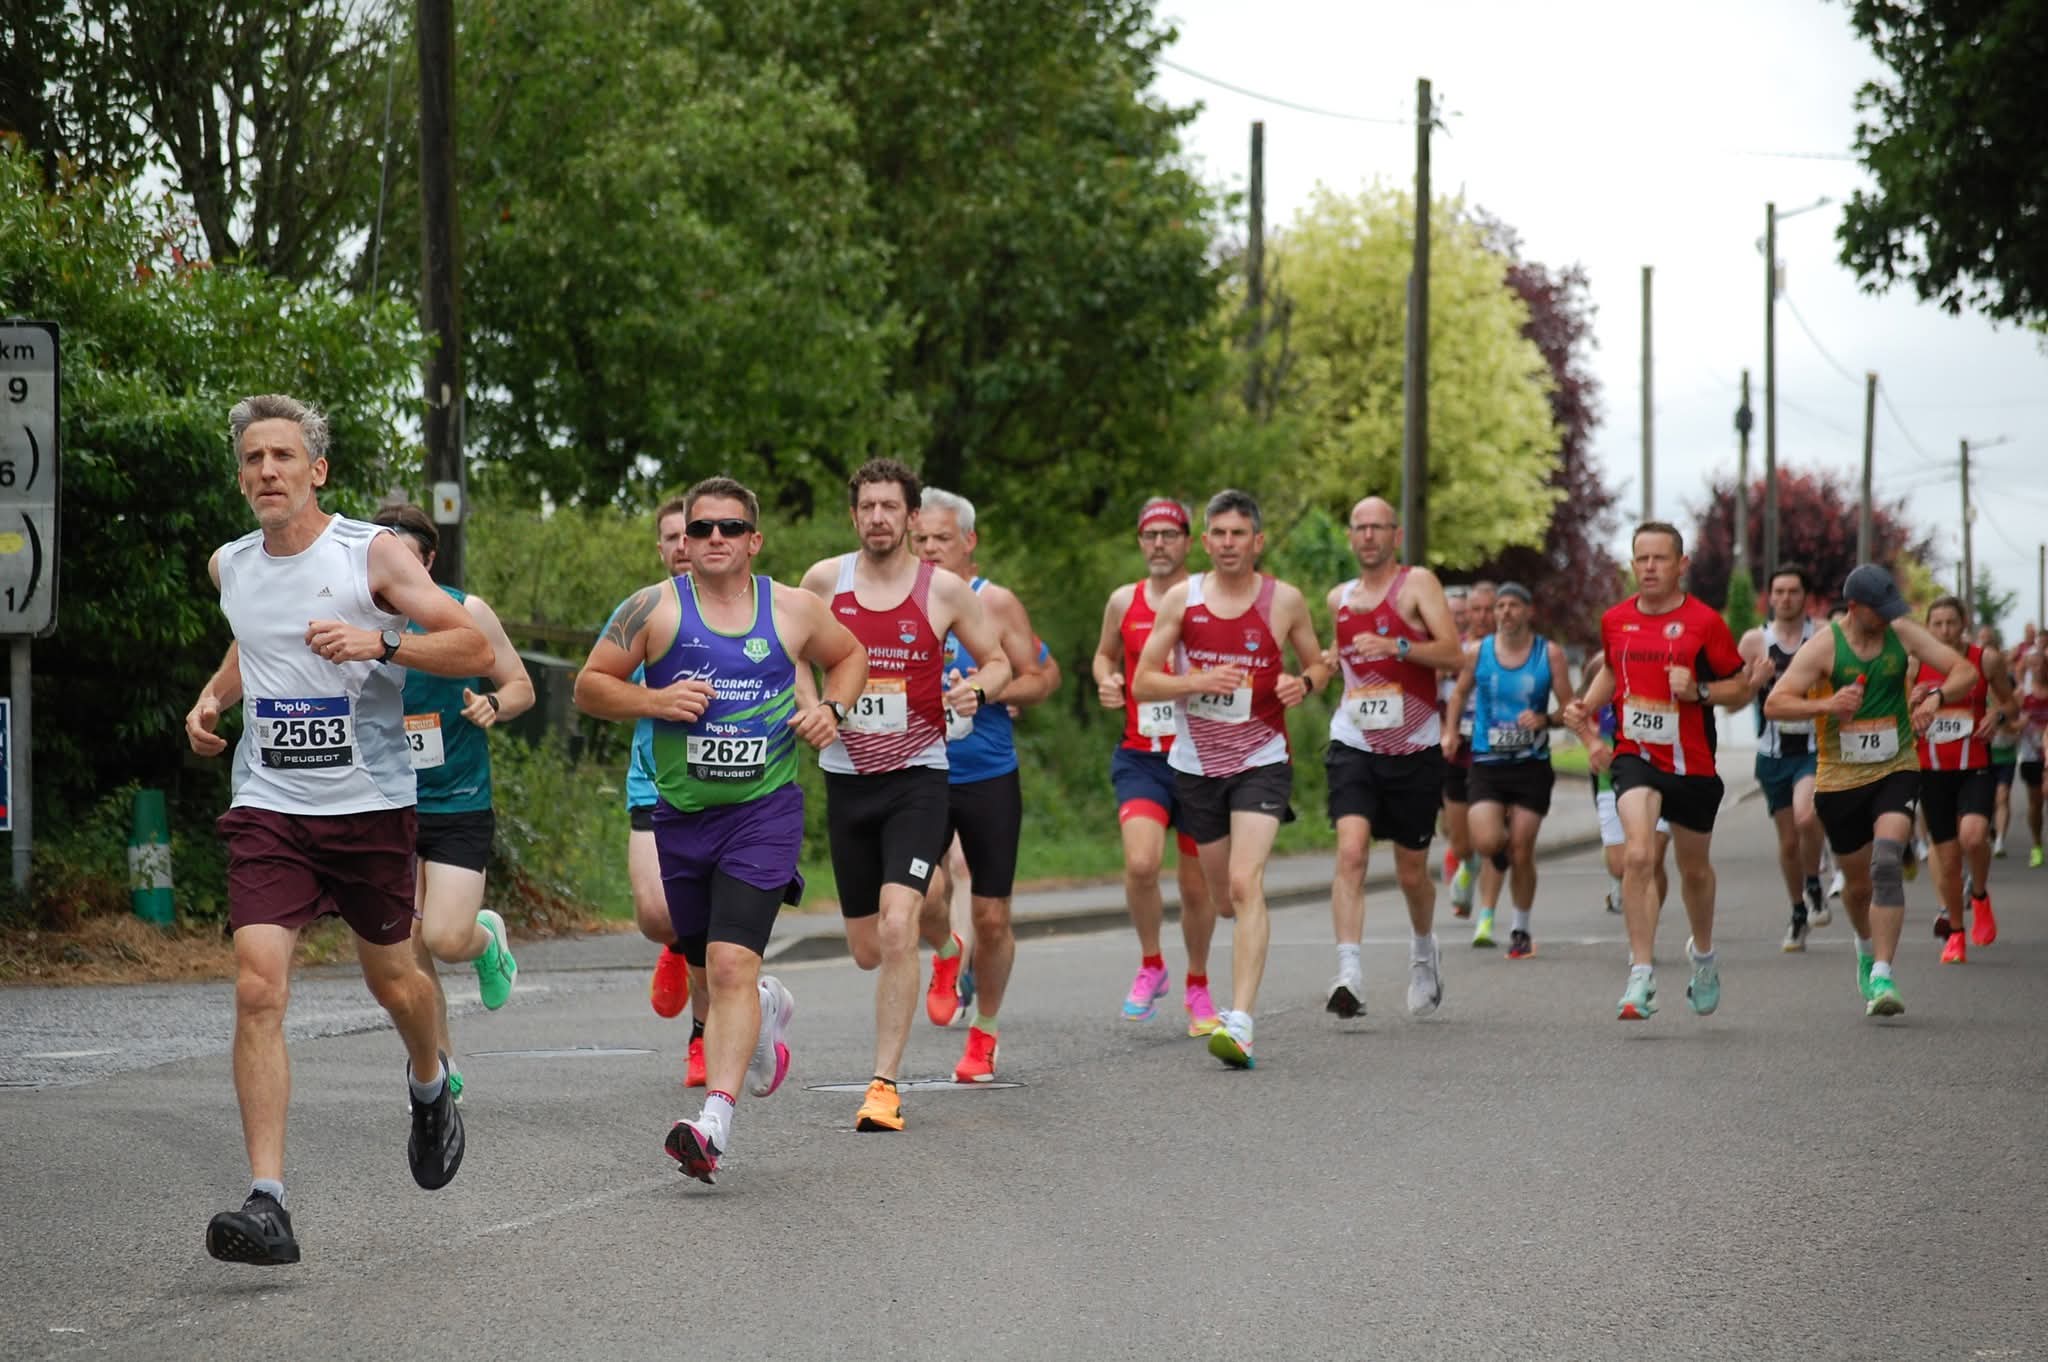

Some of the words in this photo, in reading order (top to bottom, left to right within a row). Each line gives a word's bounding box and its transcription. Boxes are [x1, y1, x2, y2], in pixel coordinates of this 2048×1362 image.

[0, 339, 34, 360] km
[274, 701, 294, 714] Pop
[296, 701, 311, 714] Up
[1152, 705, 1173, 721] 39
[1360, 701, 1388, 716] 472
[706, 722, 724, 735] Pop
[724, 723, 738, 735] Up
[1633, 711, 1664, 730] 258
[272, 718, 346, 747] 2563
[1858, 734, 1881, 750] 78
[283, 754, 341, 763] PEUGEOT
[701, 739, 763, 763] 2627
